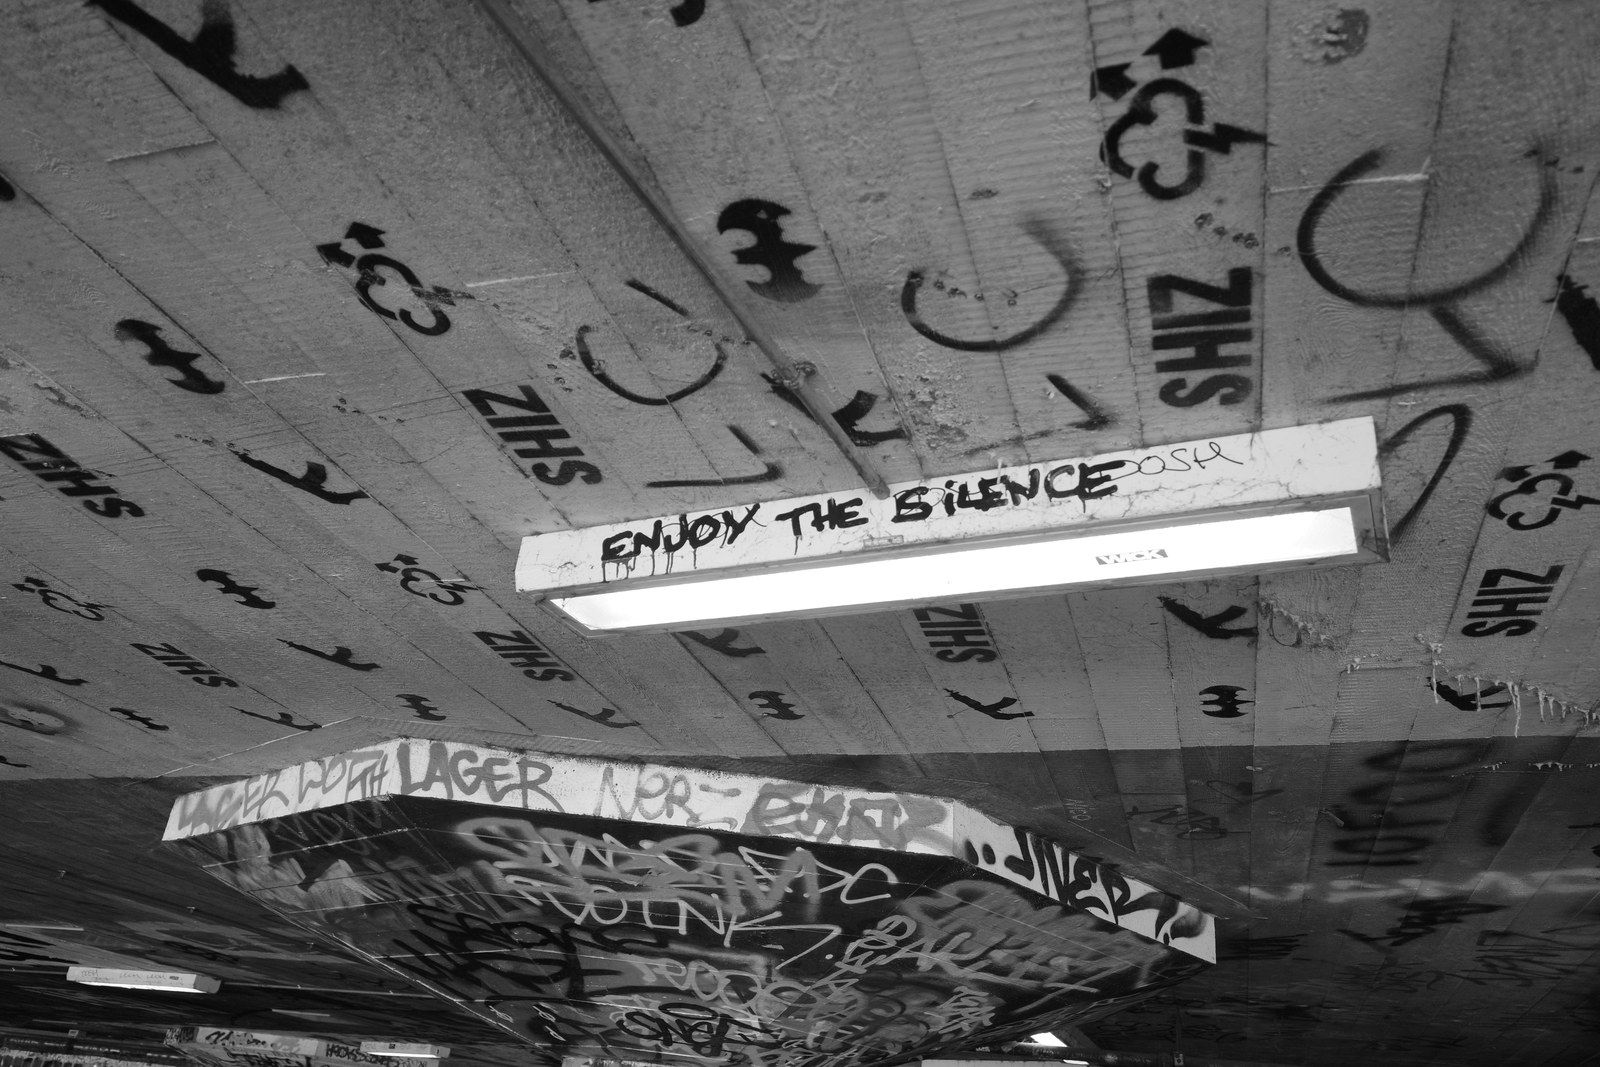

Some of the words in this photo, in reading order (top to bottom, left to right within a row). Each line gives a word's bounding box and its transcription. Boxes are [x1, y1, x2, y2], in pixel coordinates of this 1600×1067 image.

[1147, 266, 1253, 407] SHIZ
[462, 384, 602, 486] SHIZ
[601, 503, 761, 563] ENJOY
[775, 498, 869, 538] THE
[1461, 565, 1565, 638] SHIZ
[129, 643, 240, 688] SHIZ
[472, 630, 576, 682] SHIZ
[397, 742, 566, 813] LAGER
